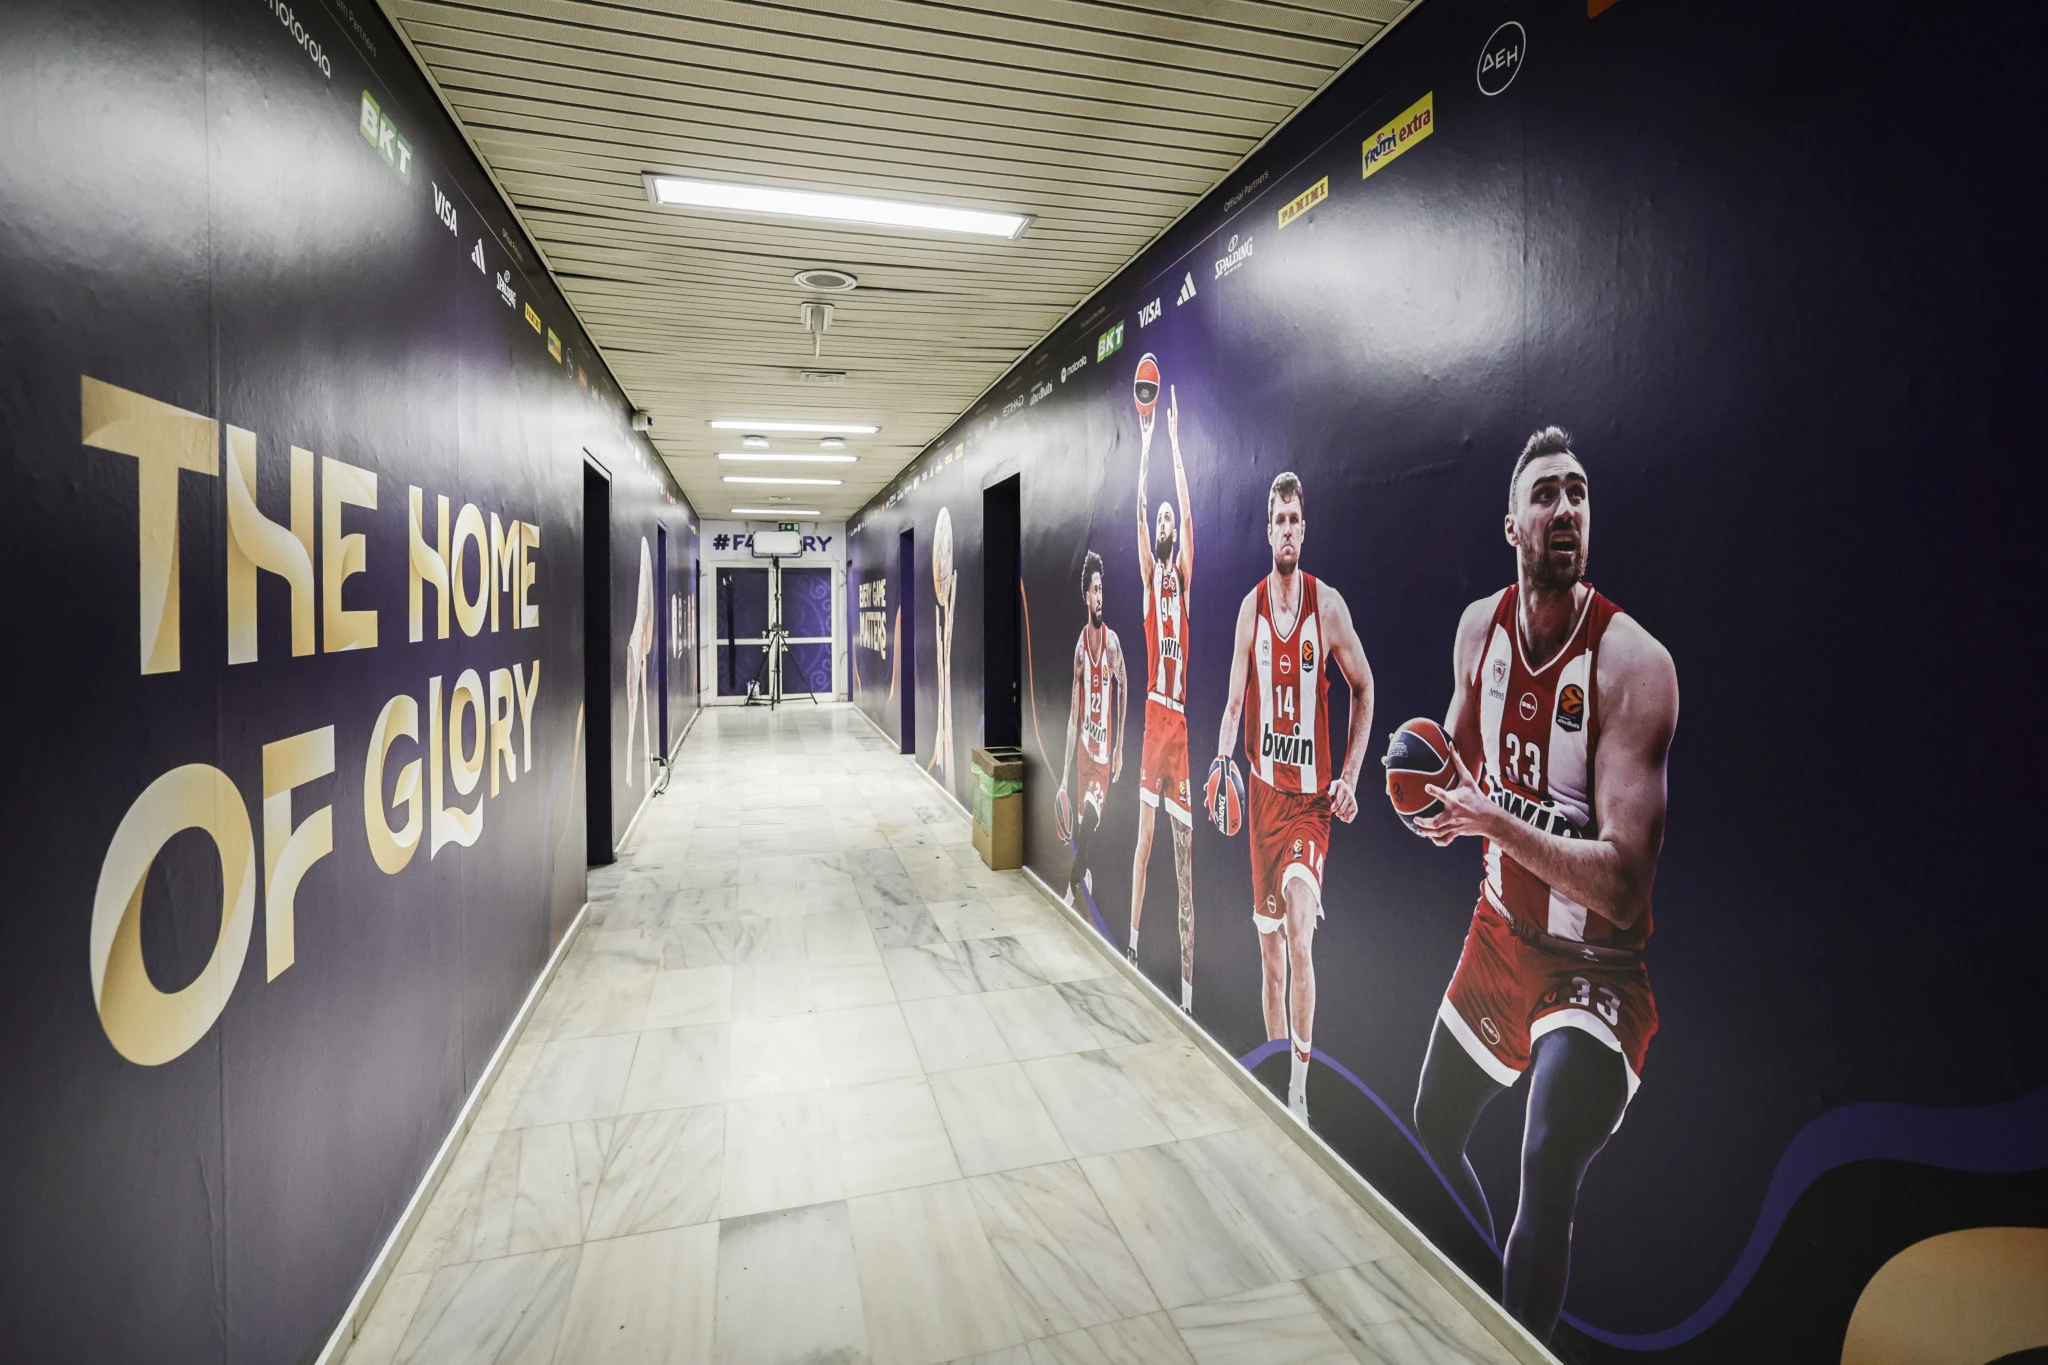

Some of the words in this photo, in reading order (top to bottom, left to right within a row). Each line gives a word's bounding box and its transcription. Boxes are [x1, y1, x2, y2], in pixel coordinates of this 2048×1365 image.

[362, 97, 411, 174] BKT
[1399, 108, 1431, 142] extra
[431, 181, 458, 237] VISA
[1281, 182, 1326, 223] PANINI
[1214, 236, 1253, 280] SPALDING
[497, 271, 517, 310] SPALDING
[1137, 297, 1161, 328] VISA
[1097, 325, 1124, 361] BKT
[1066, 355, 1087, 376] motorola
[1002, 394, 1025, 417] ETIHAD
[81, 374, 379, 675] THE
[409, 485, 540, 643] HOME
[1161, 596, 1174, 622] 94
[1091, 692, 1101, 713] 22
[1275, 684, 1295, 721] 14
[1084, 714, 1107, 744] bwin
[1262, 723, 1313, 766] bwin
[1505, 732, 1542, 792] 33
[90, 724, 335, 1067] OF
[364, 660, 540, 875] GLORY
[1569, 976, 1621, 1026] 33
